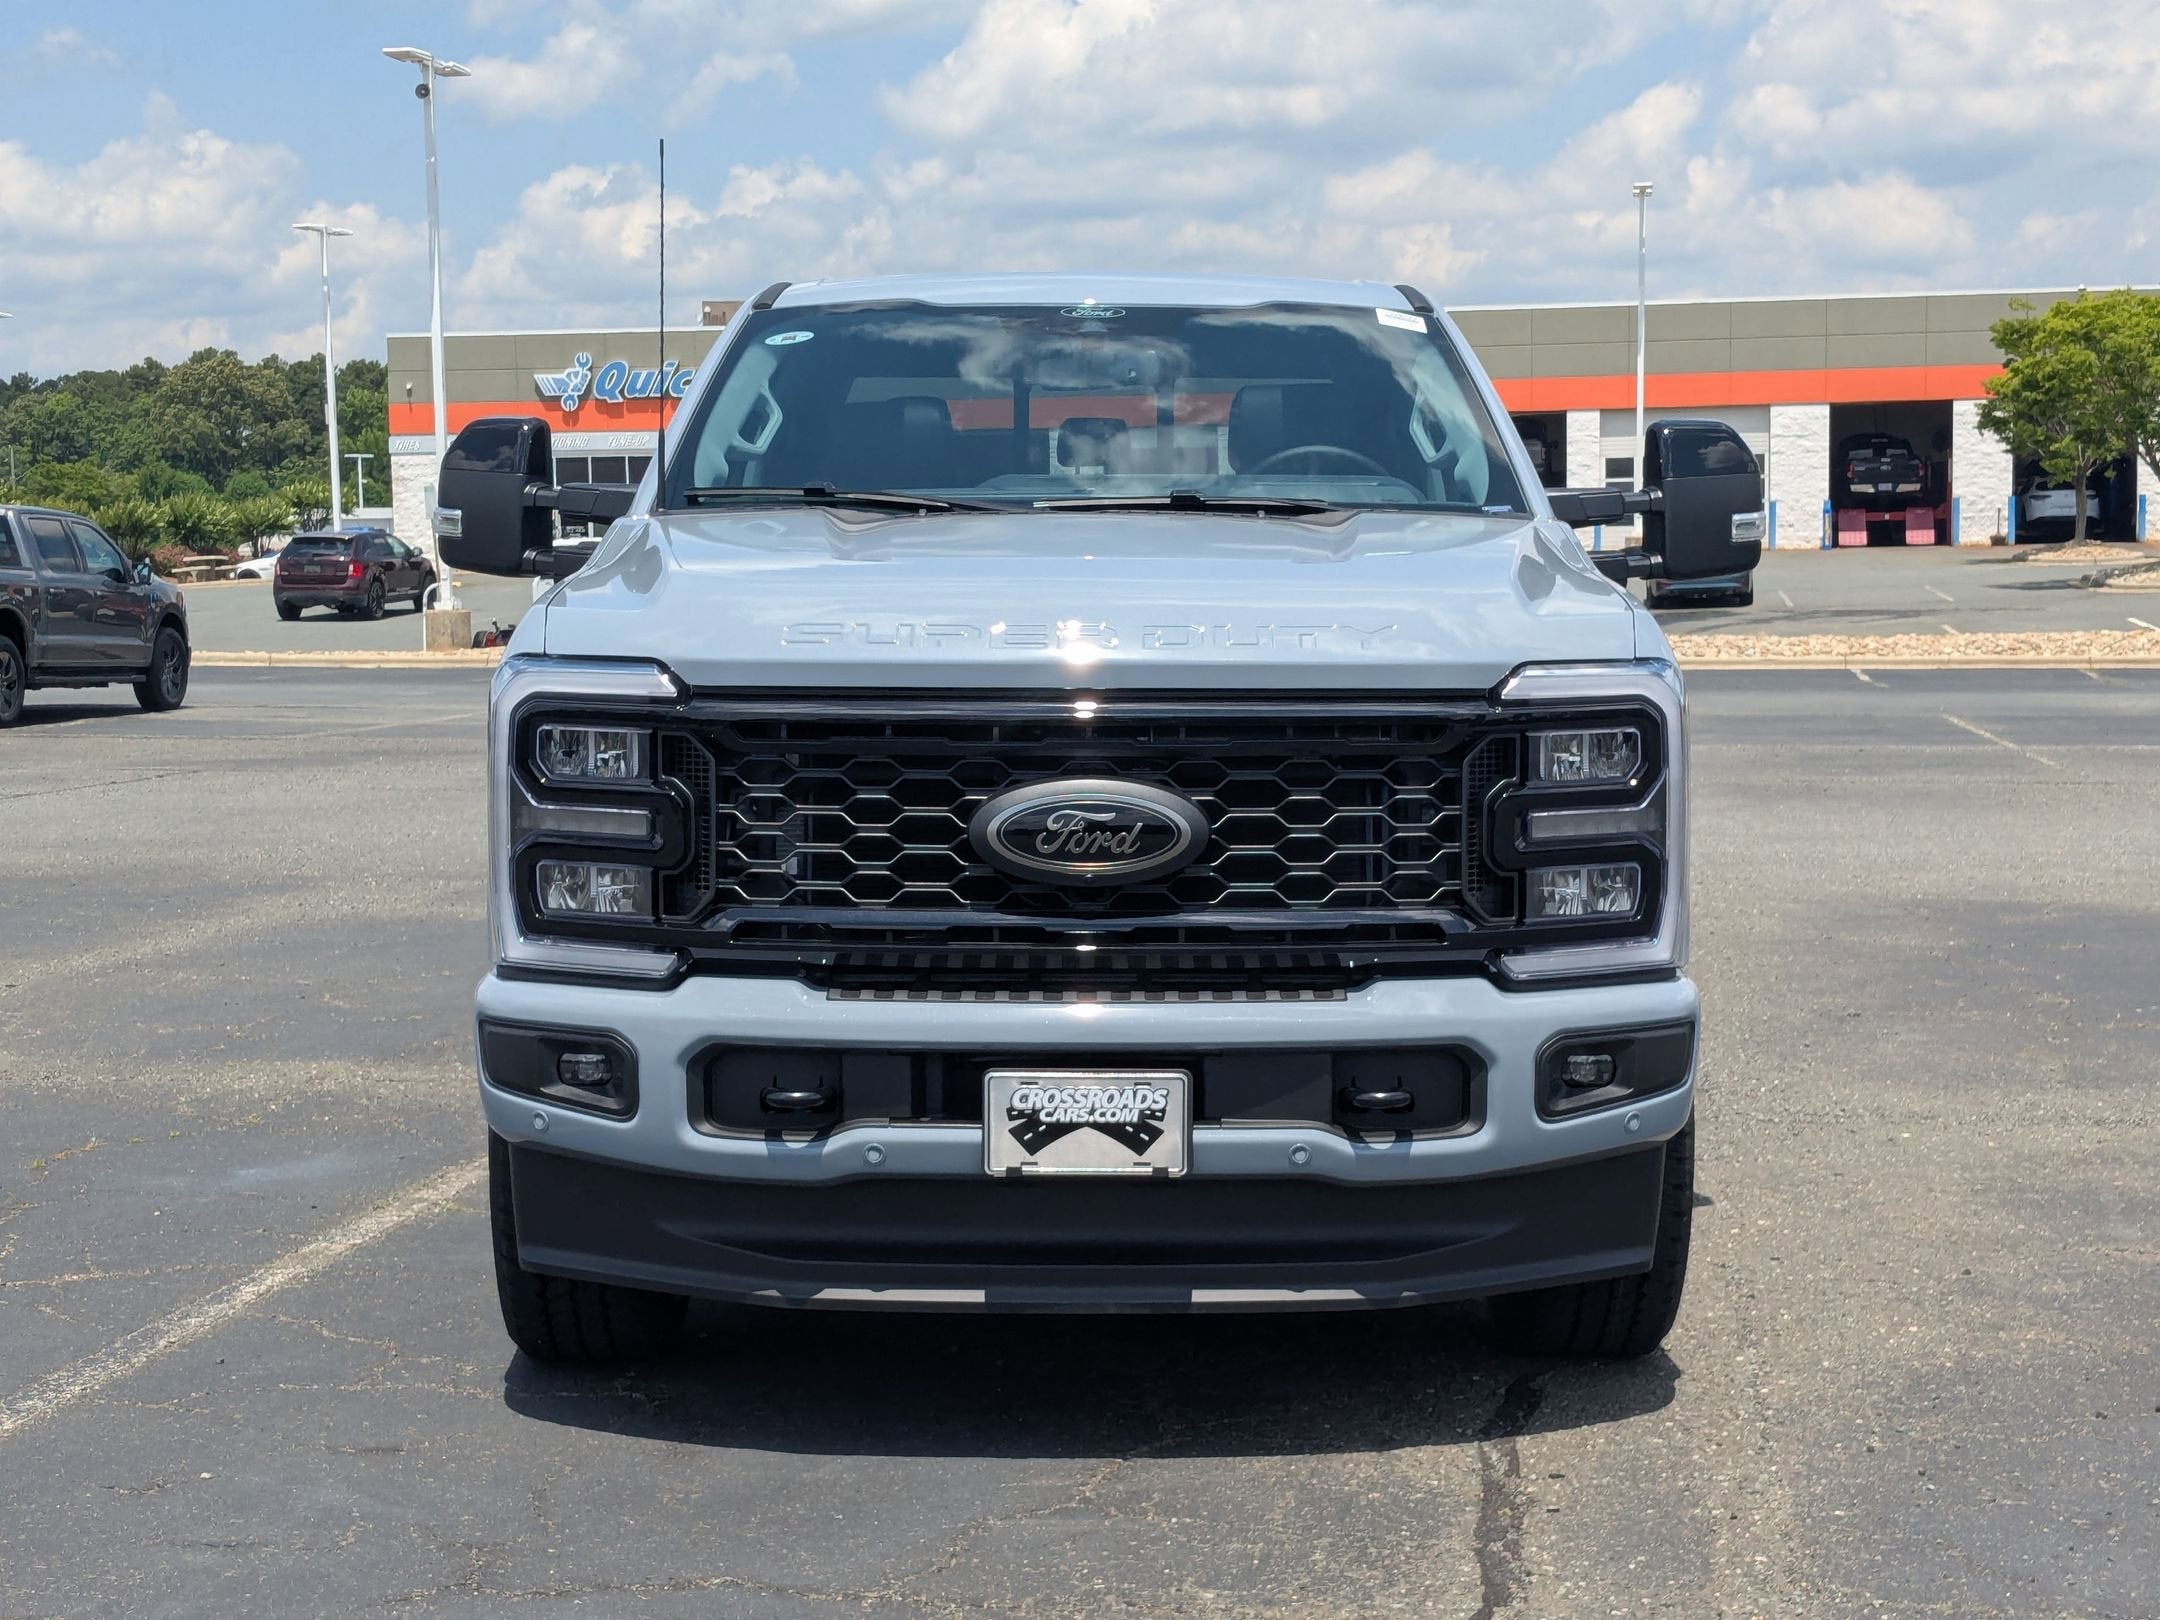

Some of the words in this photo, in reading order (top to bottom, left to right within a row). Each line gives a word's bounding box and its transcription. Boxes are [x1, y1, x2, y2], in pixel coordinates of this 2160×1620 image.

[1071, 306, 1115, 317] Ford
[593, 359, 696, 404] Quic
[783, 622, 1119, 649] SUPER
[1142, 624, 1399, 649] DUTY
[1035, 809, 1144, 855] Ford
[1010, 1086, 1170, 1111] CROSSROADS
[1038, 1107, 1141, 1123] CARS.COM
